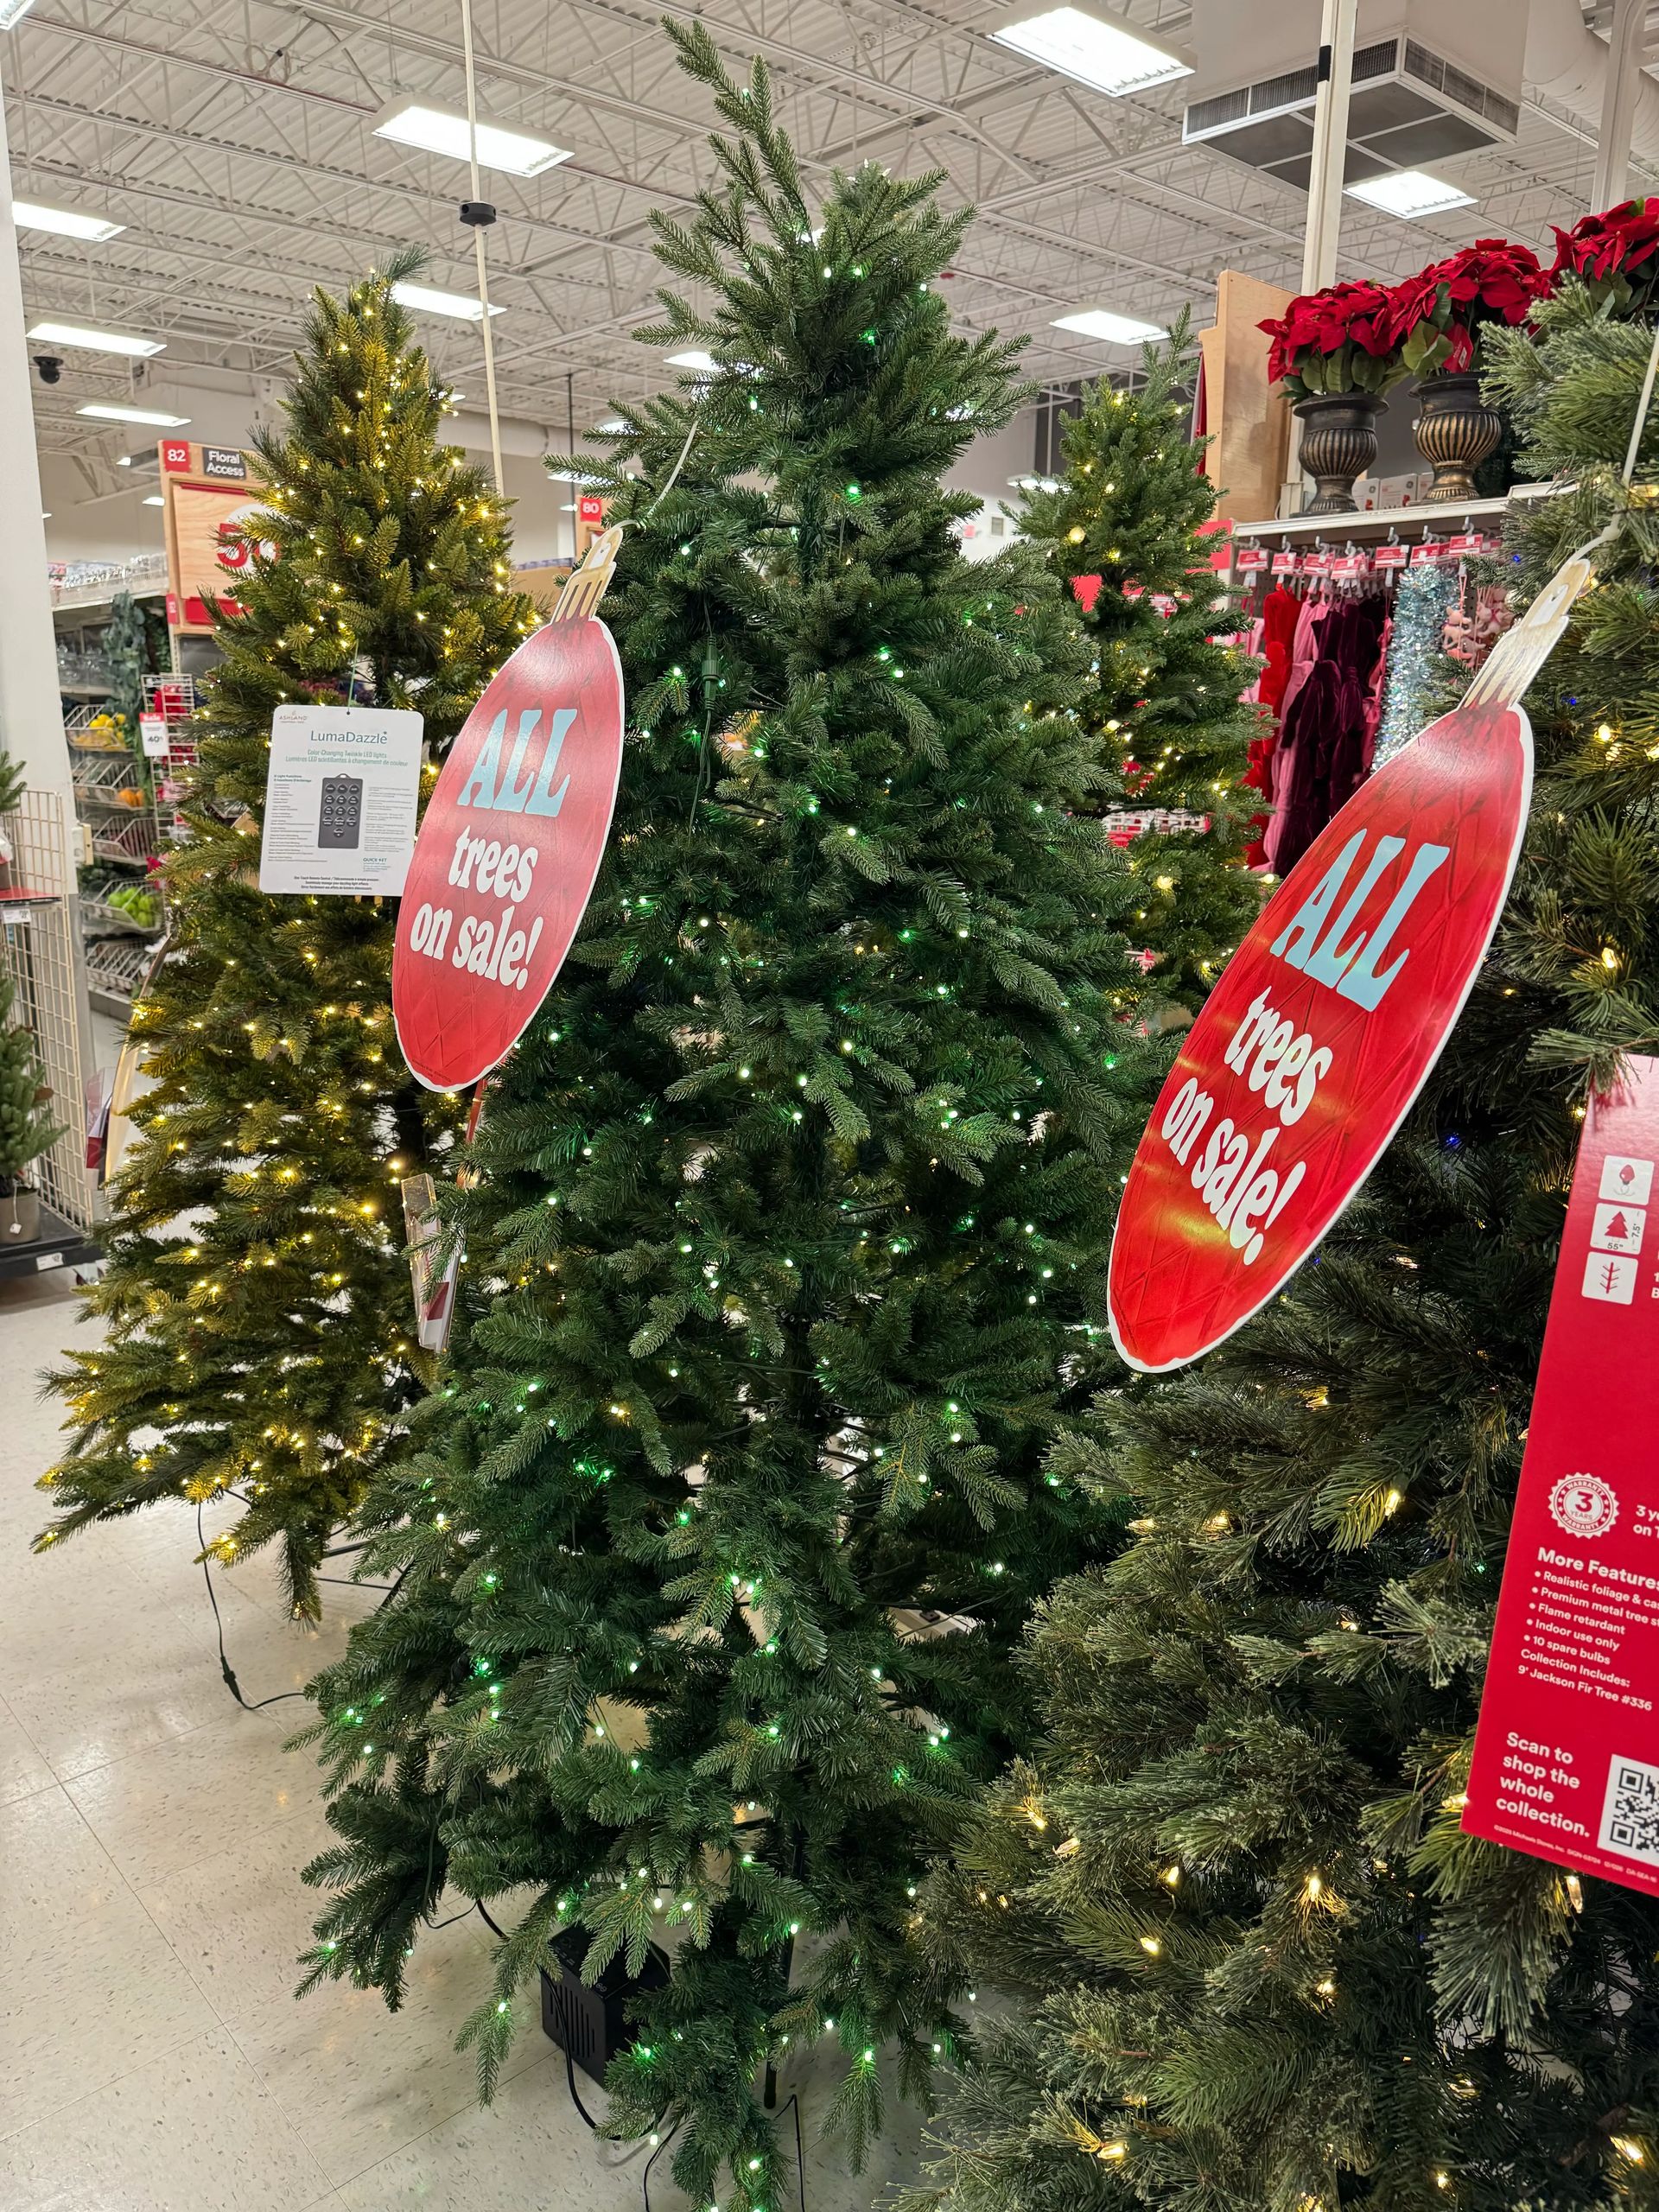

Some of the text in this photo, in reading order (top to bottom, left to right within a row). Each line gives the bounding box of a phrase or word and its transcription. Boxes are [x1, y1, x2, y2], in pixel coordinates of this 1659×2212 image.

[167, 448, 186, 462] 82
[206, 462, 245, 476] Access
[208, 450, 240, 464] Floral
[582, 502, 600, 514] 80
[310, 730, 387, 745] LumaDazzle
[457, 709, 577, 817] ALL
[448, 825, 537, 904] trees
[1269, 828, 1450, 1013] ALL
[410, 903, 544, 991] on sale!
[1224, 985, 1334, 1127] trees
[1161, 1077, 1306, 1266] on sale!
[1566, 1480, 1605, 1497] WARRANTY
[1575, 1491, 1593, 1513] 3
[1562, 1514, 1599, 1531] WARRANTY
[1570, 1510, 1593, 1520] YEARS
[1635, 1504, 1646, 1517] 3
[1632, 1524, 1652, 1537] on
[1537, 1547, 1584, 1571] More
[1543, 1571, 1589, 1592] Realistic
[1592, 1584, 1630, 1602] foliage
[1631, 1593, 1642, 1605] &
[1538, 1603, 1626, 1636] Flame retardant
[1541, 1586, 1589, 1608] Premium
[1592, 1602, 1624, 1618] metal
[1625, 1610, 1649, 1624] tree
[1533, 1636, 1611, 1665] 10 spare bulbs
[1535, 1618, 1620, 1651] Indoor use only
[1521, 1649, 1630, 1688] Collection Includes:
[1517, 1664, 1653, 1712] 9' Jackson Fir Tree #336
[1506, 1732, 1573, 1765] Scan to
[1503, 1755, 1581, 1789] shop the
[1499, 1776, 1554, 1803] whole
[1496, 1796, 1591, 1838] collection.
